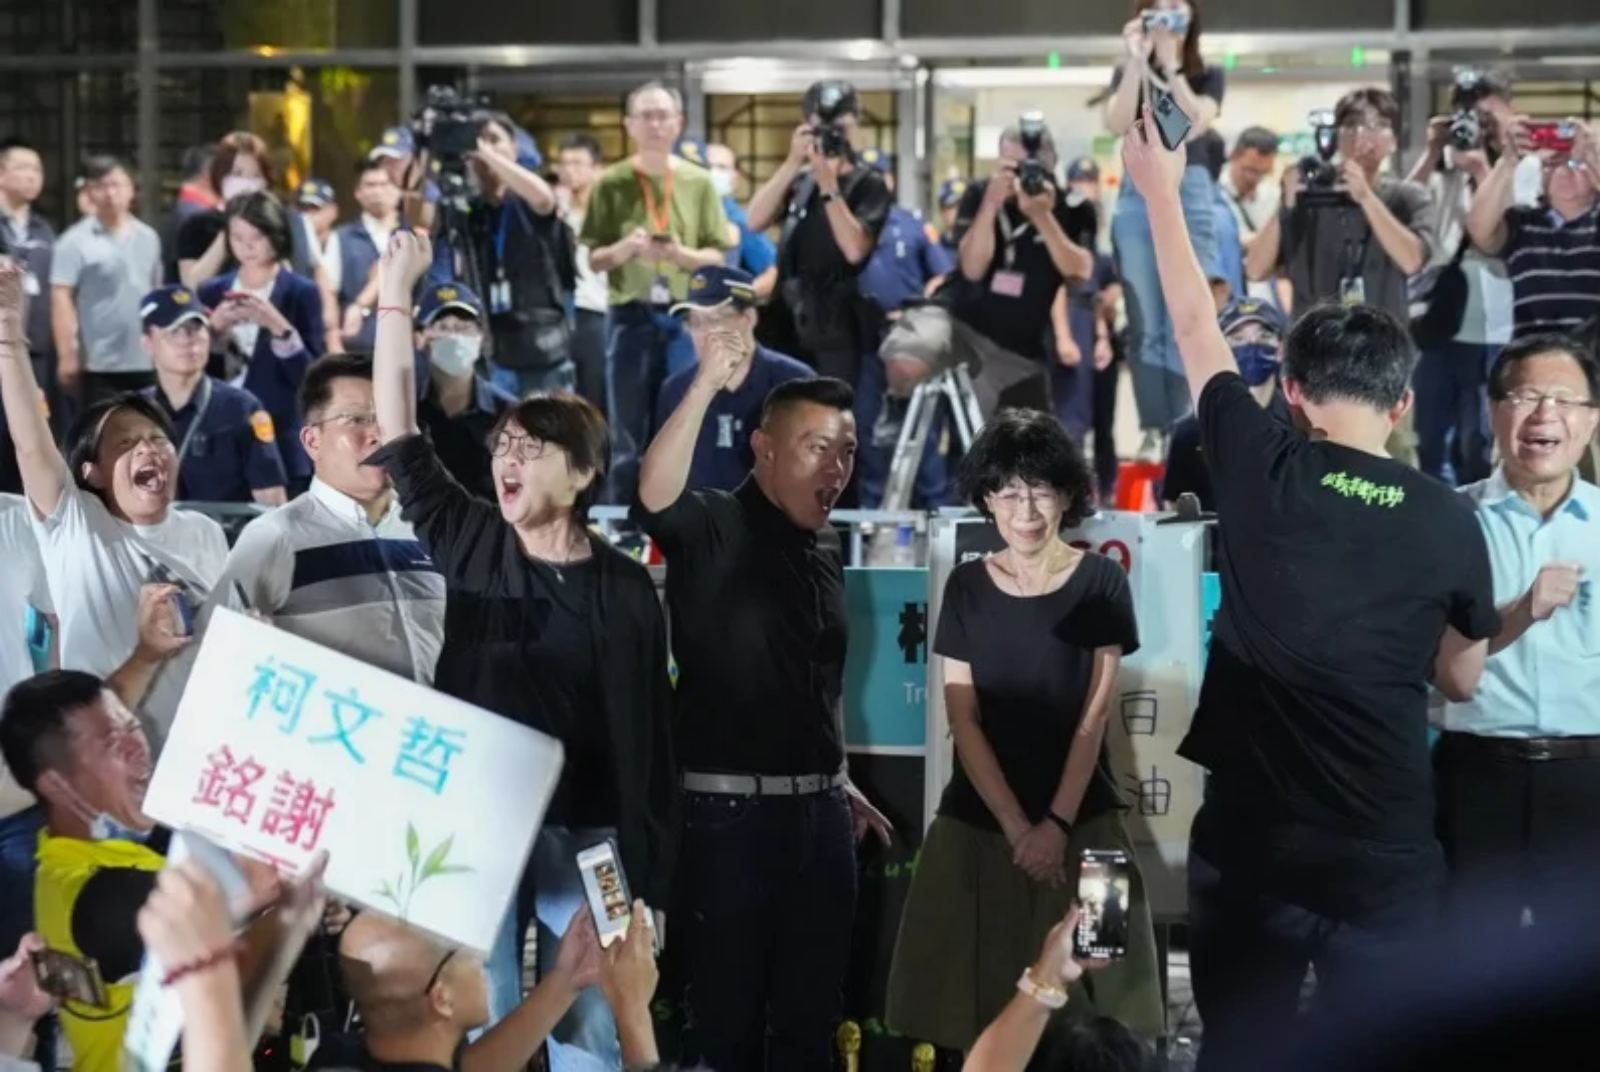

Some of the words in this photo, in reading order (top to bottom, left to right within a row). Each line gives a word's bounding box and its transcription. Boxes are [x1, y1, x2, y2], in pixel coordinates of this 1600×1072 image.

[246, 656, 468, 795] 柯文哲
[902, 682, 928, 706] Tr
[191, 744, 337, 851] 銘謝
